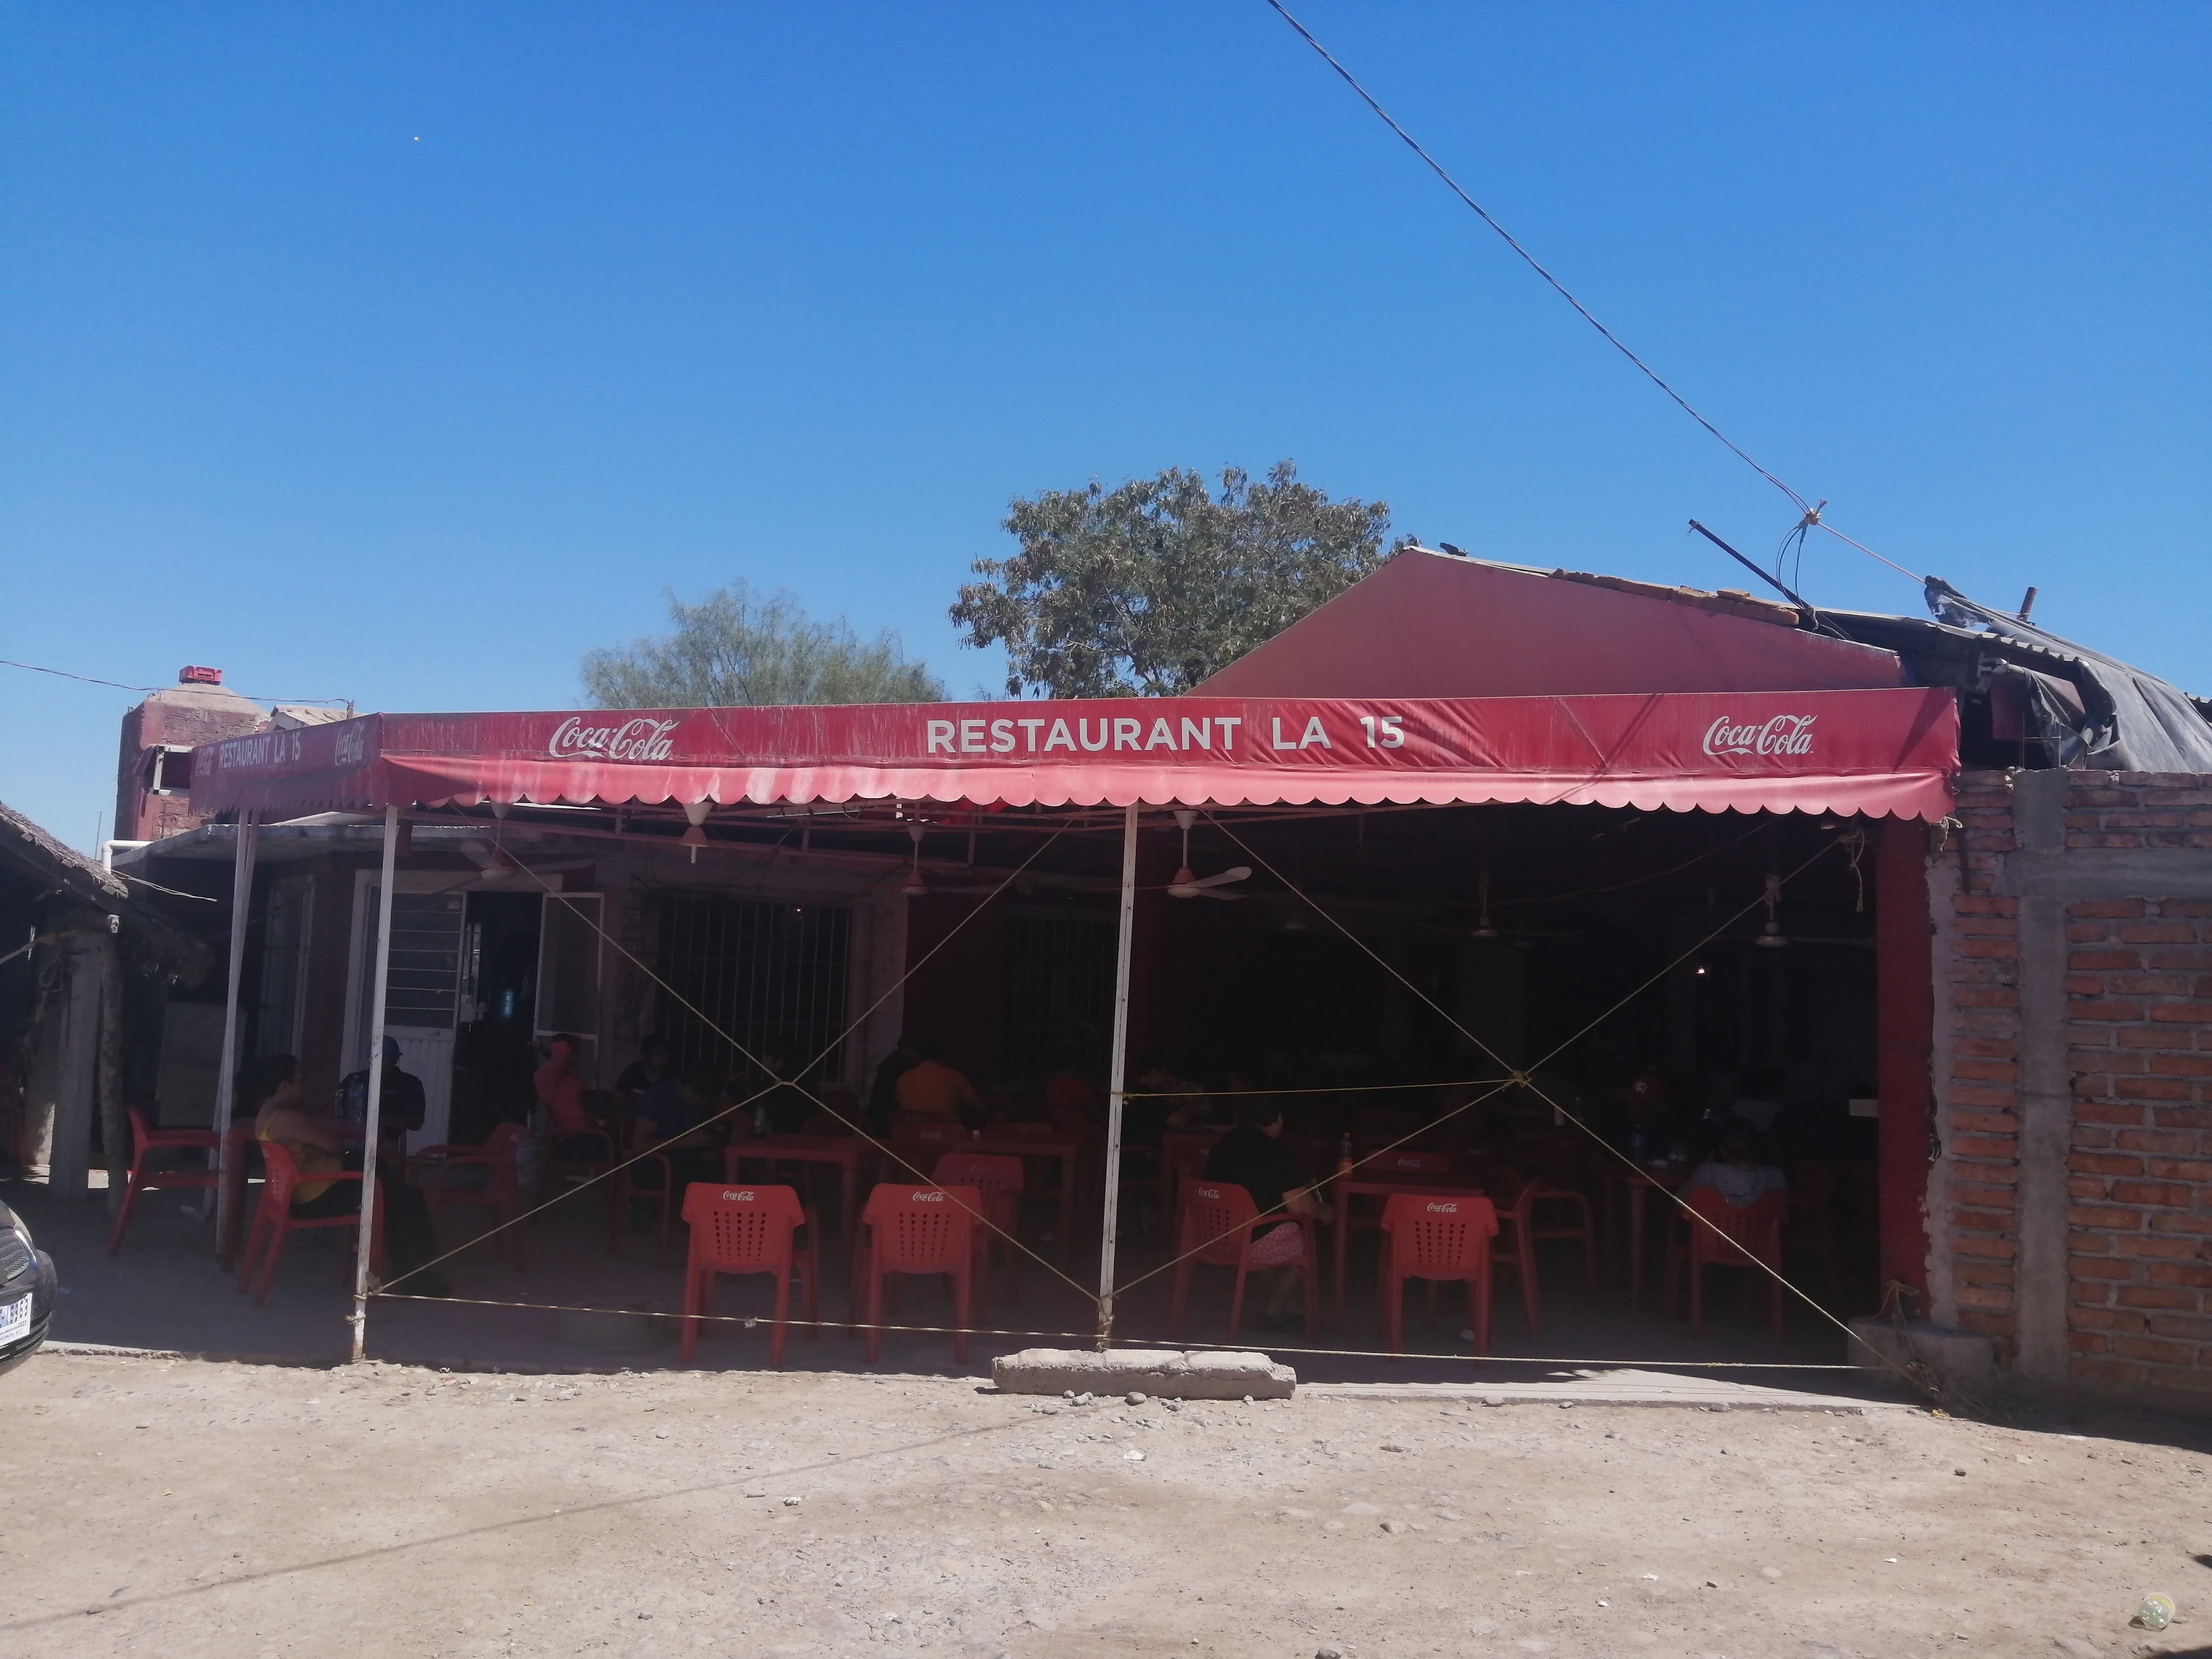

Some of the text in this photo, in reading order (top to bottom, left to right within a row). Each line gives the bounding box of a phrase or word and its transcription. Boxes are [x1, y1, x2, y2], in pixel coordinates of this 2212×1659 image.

[219, 736, 271, 769] RESTAURANT
[274, 733, 286, 763] LA
[291, 731, 301, 761] 15
[548, 716, 681, 761] Coca-Cola
[928, 716, 1404, 753] RESTAURANT LA 15
[1702, 715, 1818, 755] Coca-Cola
[723, 1190, 755, 1201] Coca-Cola
[1427, 1202, 1458, 1212] Coca-Cola
